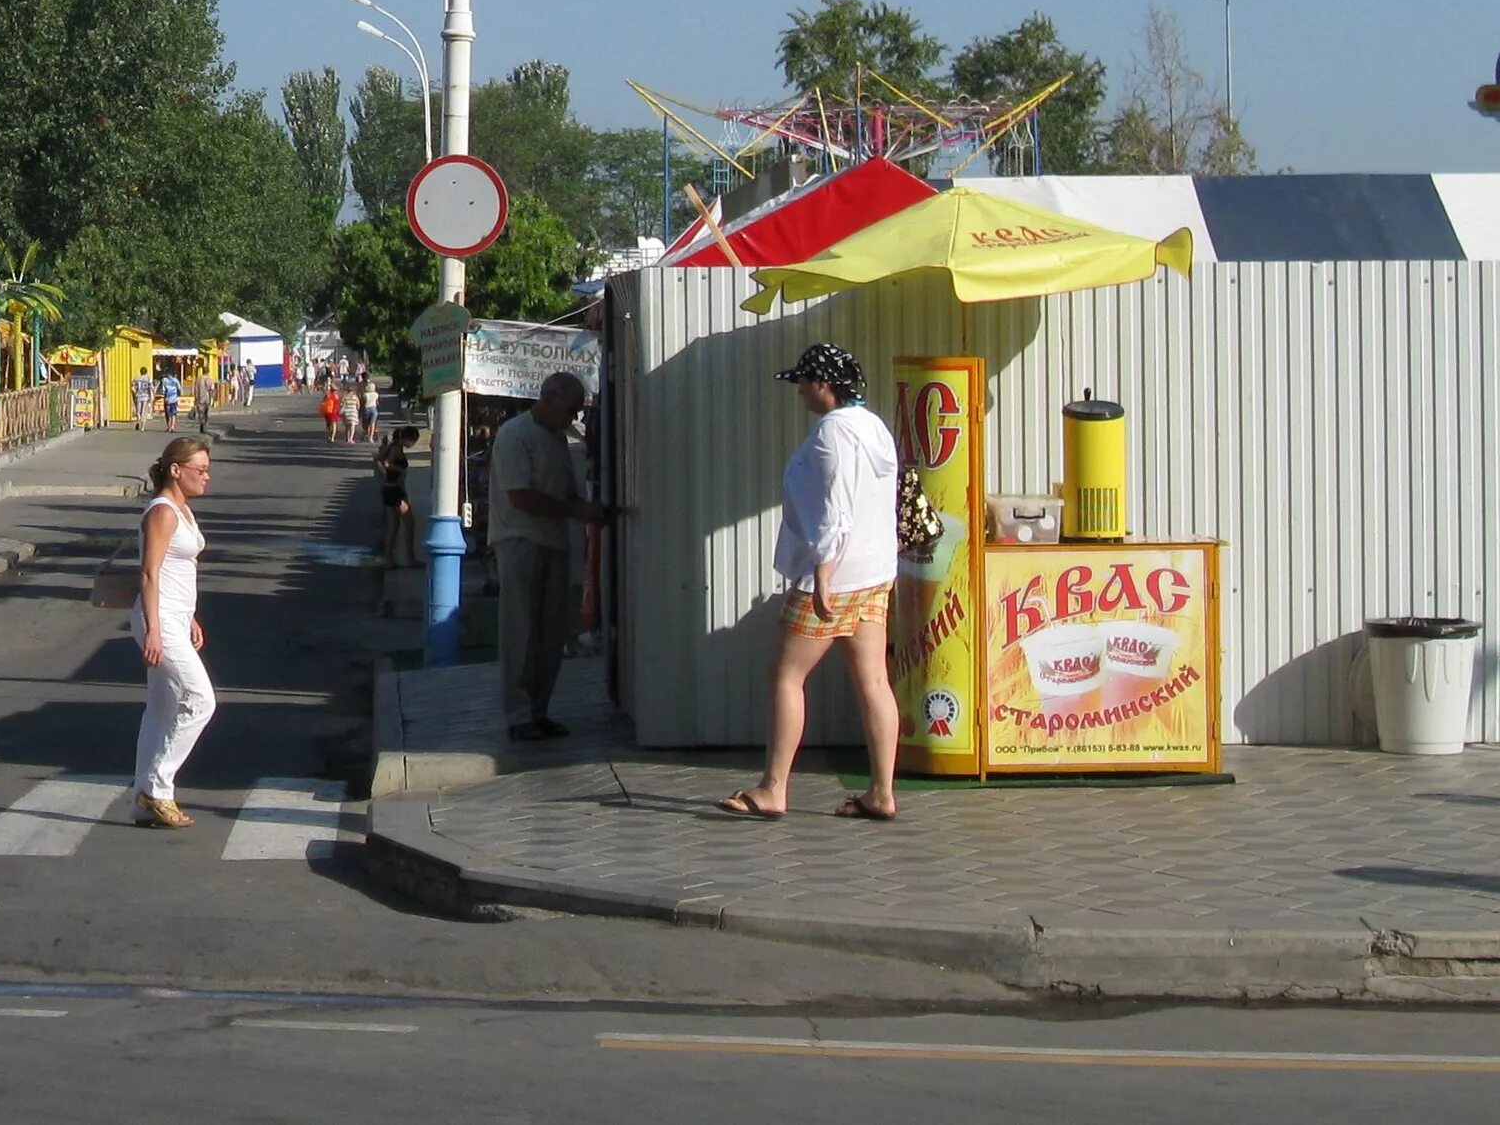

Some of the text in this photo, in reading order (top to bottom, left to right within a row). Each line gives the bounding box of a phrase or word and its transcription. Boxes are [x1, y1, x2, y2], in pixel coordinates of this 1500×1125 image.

[500, 339, 598, 365] ФУТБОЛКАХ
[508, 368, 543, 382] ПОЖЕЛ
[1000, 563, 1190, 650] КВАС
[995, 745, 1017, 754] ООО
[1143, 743, 1202, 754] www.kwas.ru
